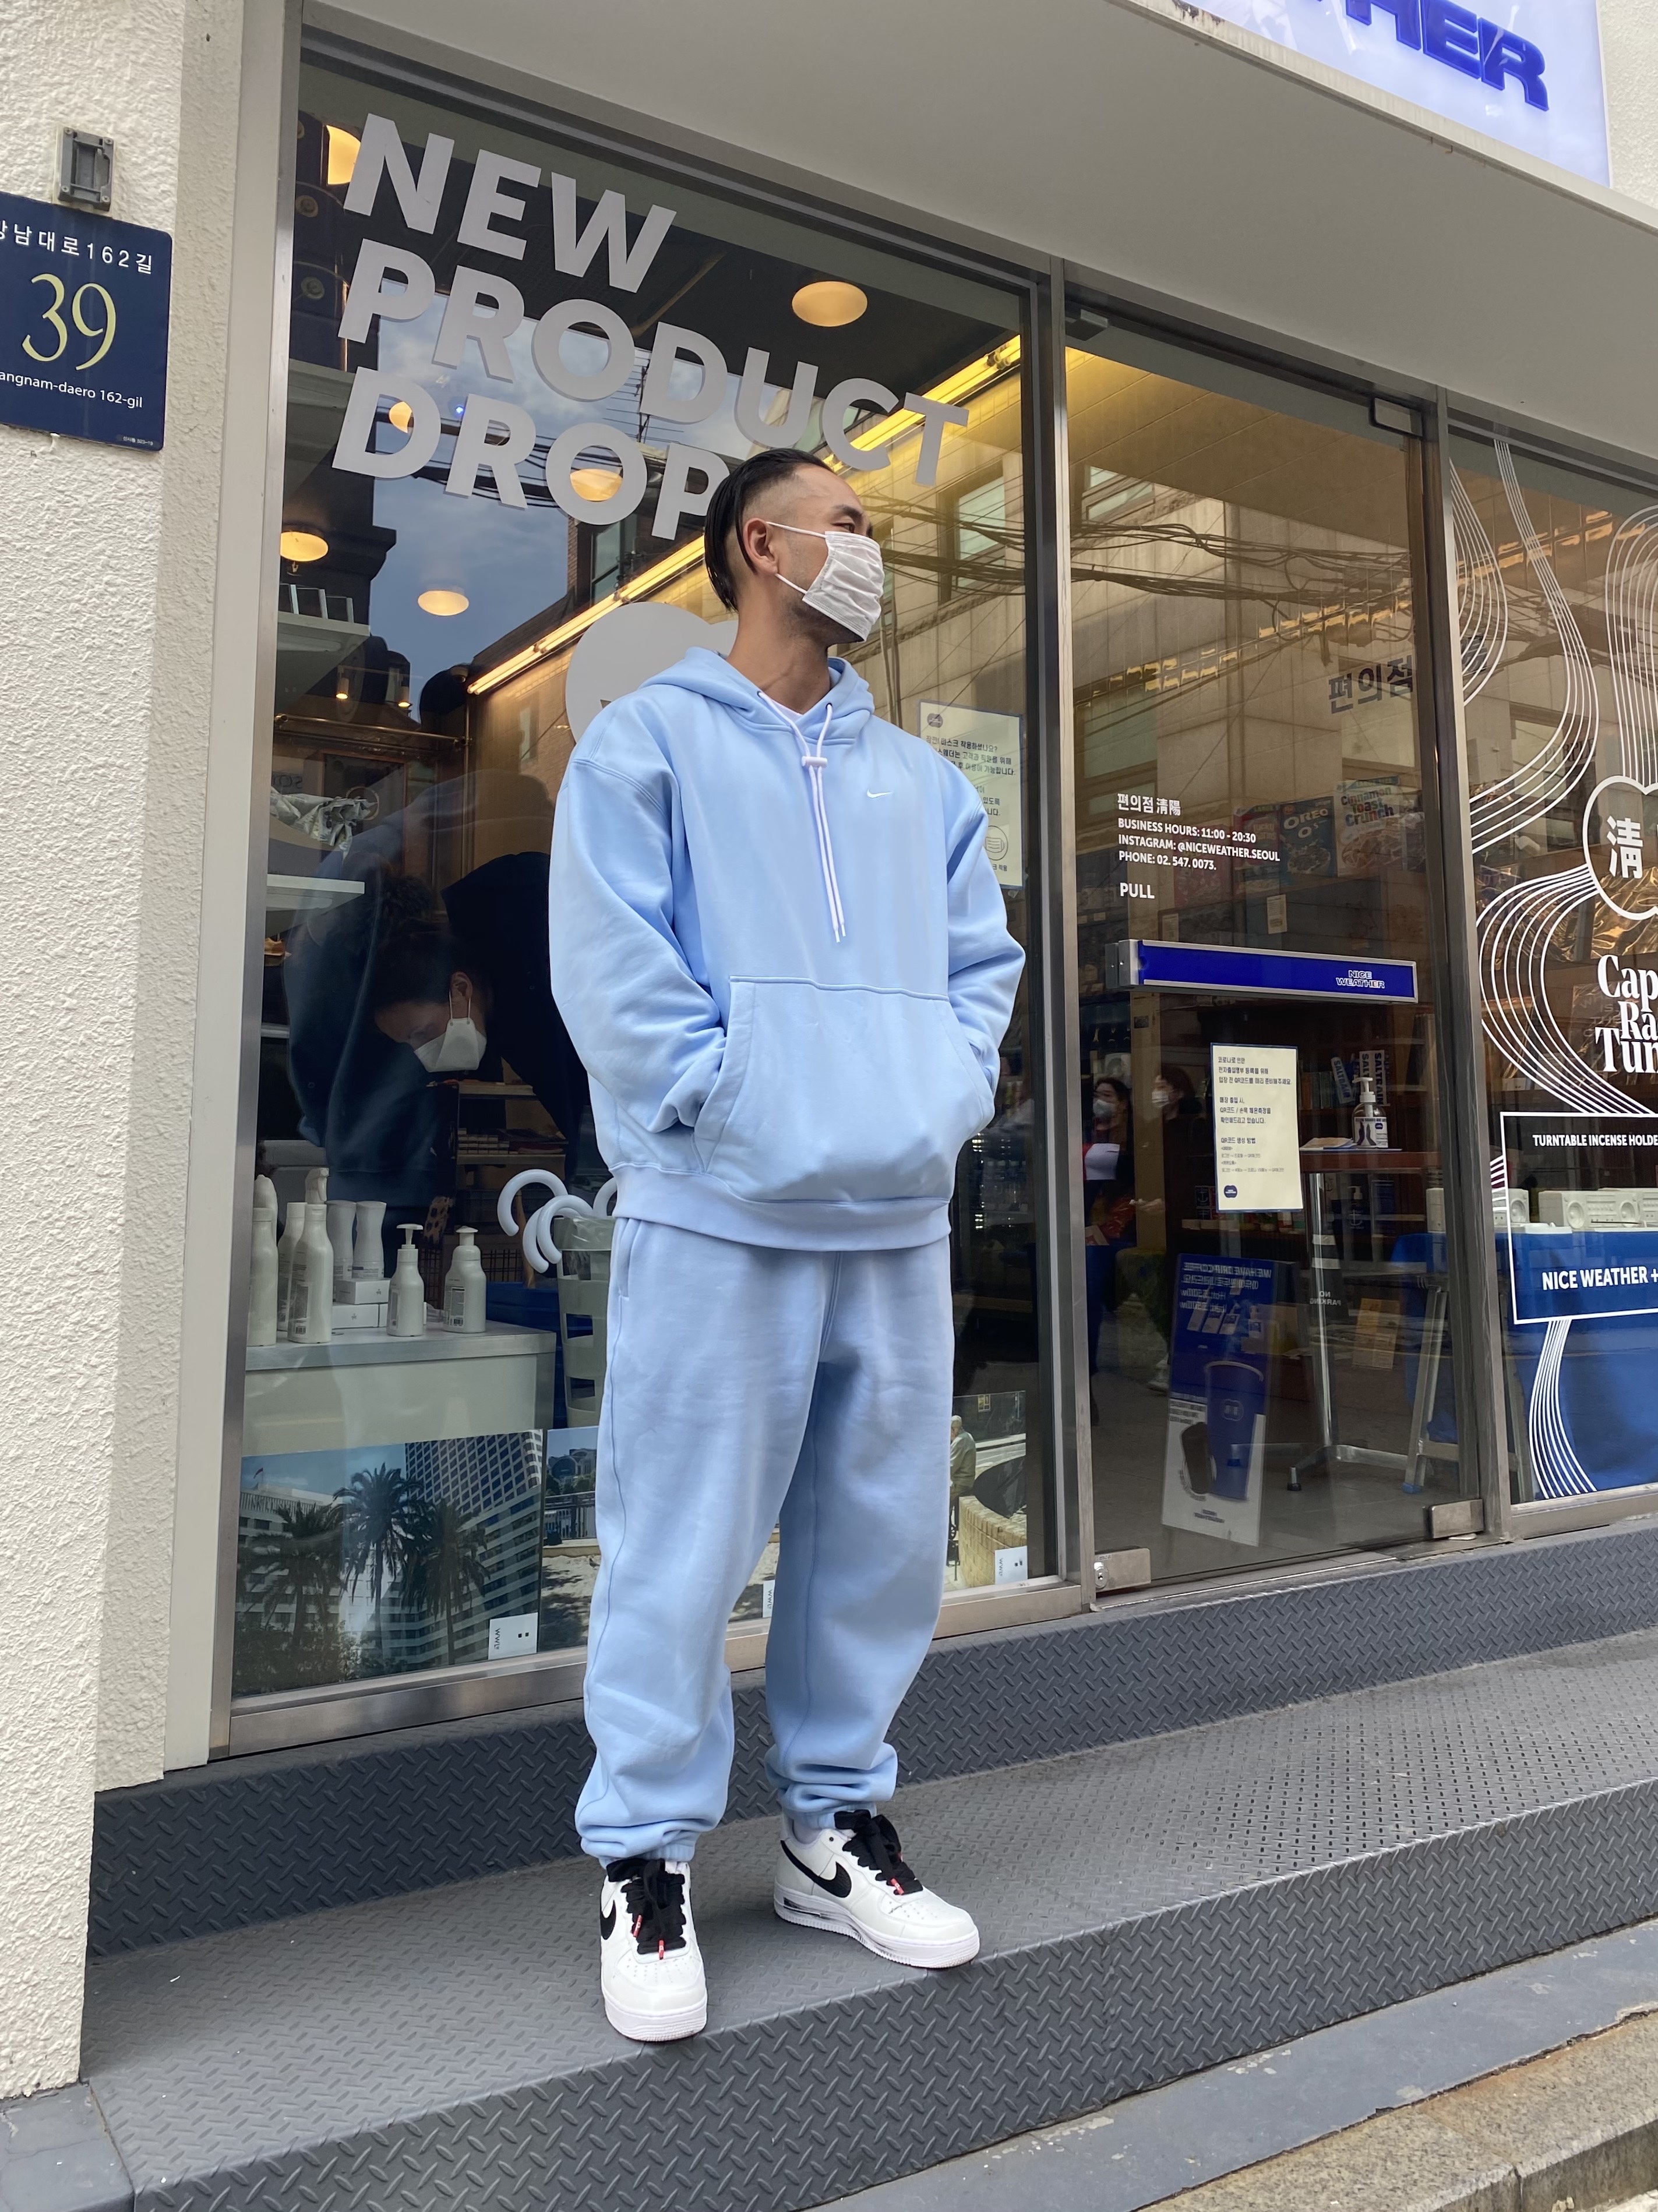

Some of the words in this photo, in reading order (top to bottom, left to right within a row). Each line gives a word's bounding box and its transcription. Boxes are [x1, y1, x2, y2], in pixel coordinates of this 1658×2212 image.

[343, 112, 677, 294] NEW
[22, 273, 117, 370] 39
[338, 238, 969, 487] PRODUCT
[100, 388, 143, 409] 162-gil
[332, 366, 731, 540] DROP
[1328, 655, 1413, 714] 편의점
[941, 738, 959, 747] 마스크
[987, 808, 1001, 816] 니다.
[1117, 793, 1153, 814] 편의점
[1118, 817, 1163, 833] BUSINESS
[1165, 823, 1200, 838] HOURS:
[1201, 828, 1225, 840] 11:00
[1232, 831, 1256, 843] 20:30
[1283, 808, 1328, 830] OREO
[1119, 834, 1176, 850] INSTAGRAM:
[1178, 841, 1280, 861] @NICEWEATHER.SEOUL
[1119, 850, 1155, 864] PHONE:
[1156, 854, 1170, 865] 02.
[1172, 856, 1191, 868] 547.
[1192, 859, 1216, 871] 0073.
[1120, 882, 1155, 899] PULL
[1336, 977, 1385, 989] WEATHER
[1348, 970, 1372, 979] NICE
[1597, 954, 1658, 1012] Cap
[1532, 1134, 1587, 1147] TURNTABLE
[1589, 1134, 1628, 1147] INCENSE
[1542, 1270, 1578, 1291] NICE
[1580, 1266, 1649, 1288] WEATHER
